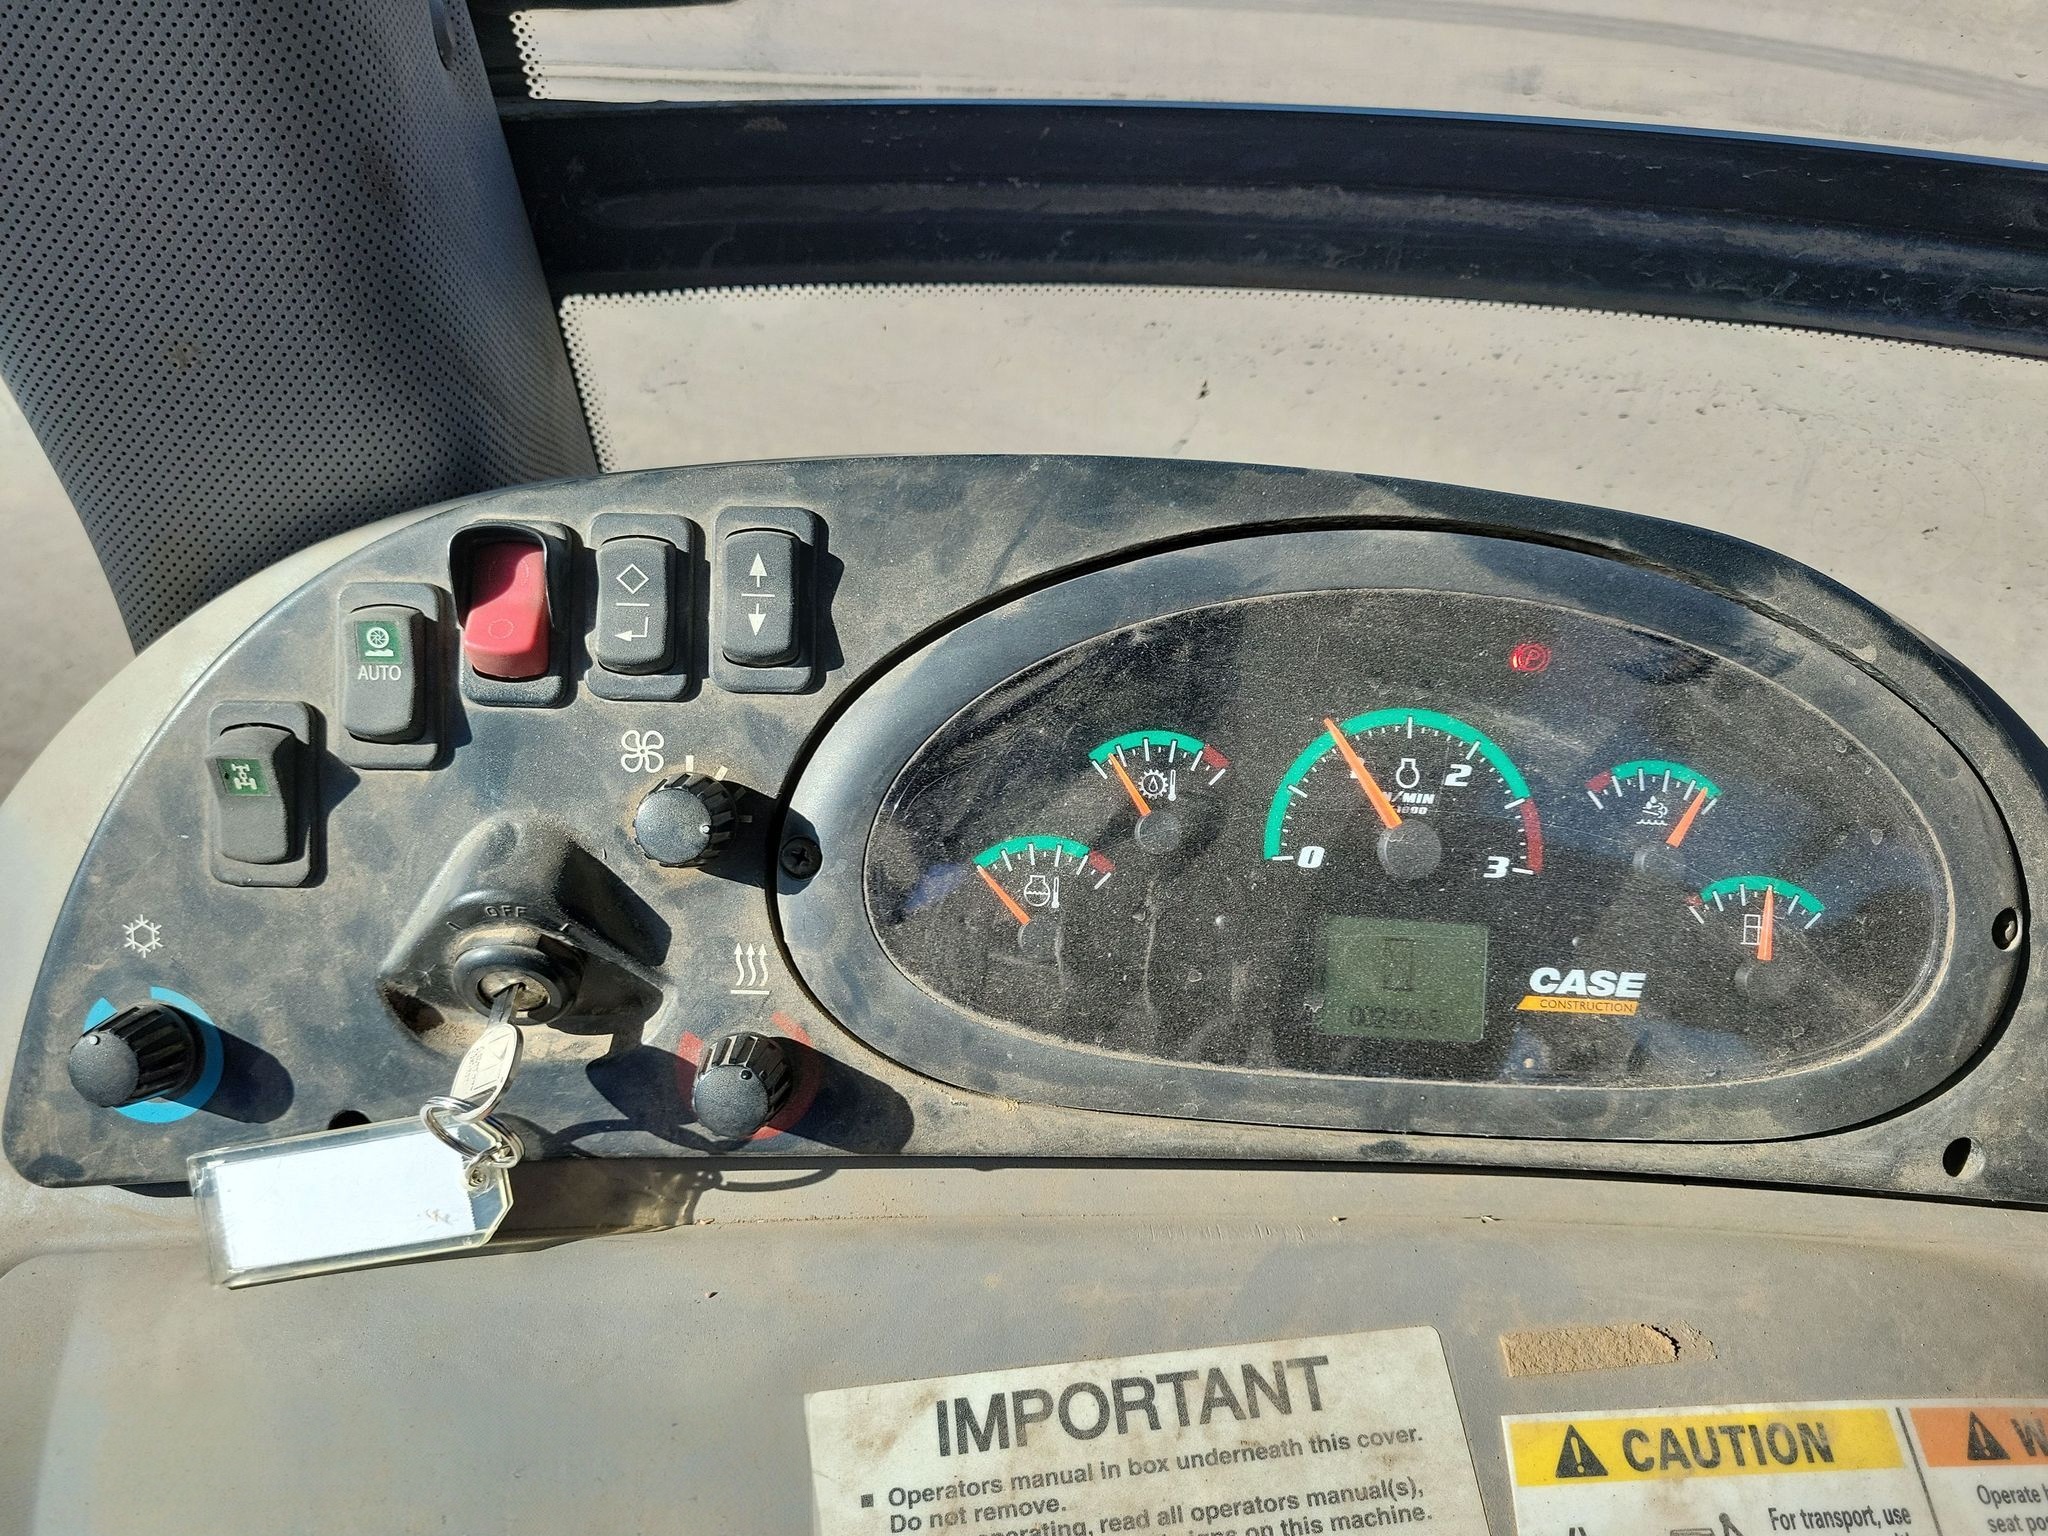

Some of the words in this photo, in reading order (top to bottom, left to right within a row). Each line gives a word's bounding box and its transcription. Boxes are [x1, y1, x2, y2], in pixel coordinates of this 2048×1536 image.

[357, 664, 402, 681] AUTO
[1444, 764, 1473, 787] 2
[1298, 846, 1325, 868] 0
[1483, 856, 1511, 879] 3
[485, 904, 527, 917] OFF
[1529, 967, 1647, 997] CASE
[1539, 999, 1635, 1014] CONSTRUCTION
[937, 1356, 1328, 1456] IMPORTANT
[1622, 1422, 1835, 1472] CAUTION
[888, 1477, 1003, 1508] Operators
[1011, 1463, 1093, 1490] manual
[1100, 1461, 1121, 1479] in
[1128, 1456, 1169, 1476] box
[1176, 1438, 1303, 1469] underneath
[1308, 1433, 1350, 1454] this
[1357, 1427, 1422, 1448] cover.
[1100, 1509, 1150, 1533] read
[1157, 1505, 1184, 1526] all
[1191, 1495, 1300, 1525] operators
[1306, 1475, 1424, 1507] manual(s),
[1977, 1484, 2041, 1509] Operate
[890, 1514, 922, 1533] Do
[930, 1507, 967, 1528] not
[974, 1498, 1067, 1523] remove.
[1280, 1516, 1324, 1536] this
[1330, 1505, 1432, 1532] machine.
[1768, 1506, 1796, 1530] For
[1800, 1504, 1881, 1533] transport,
[1882, 1507, 1911, 1526] use
[1987, 1514, 2024, 1533] seat
